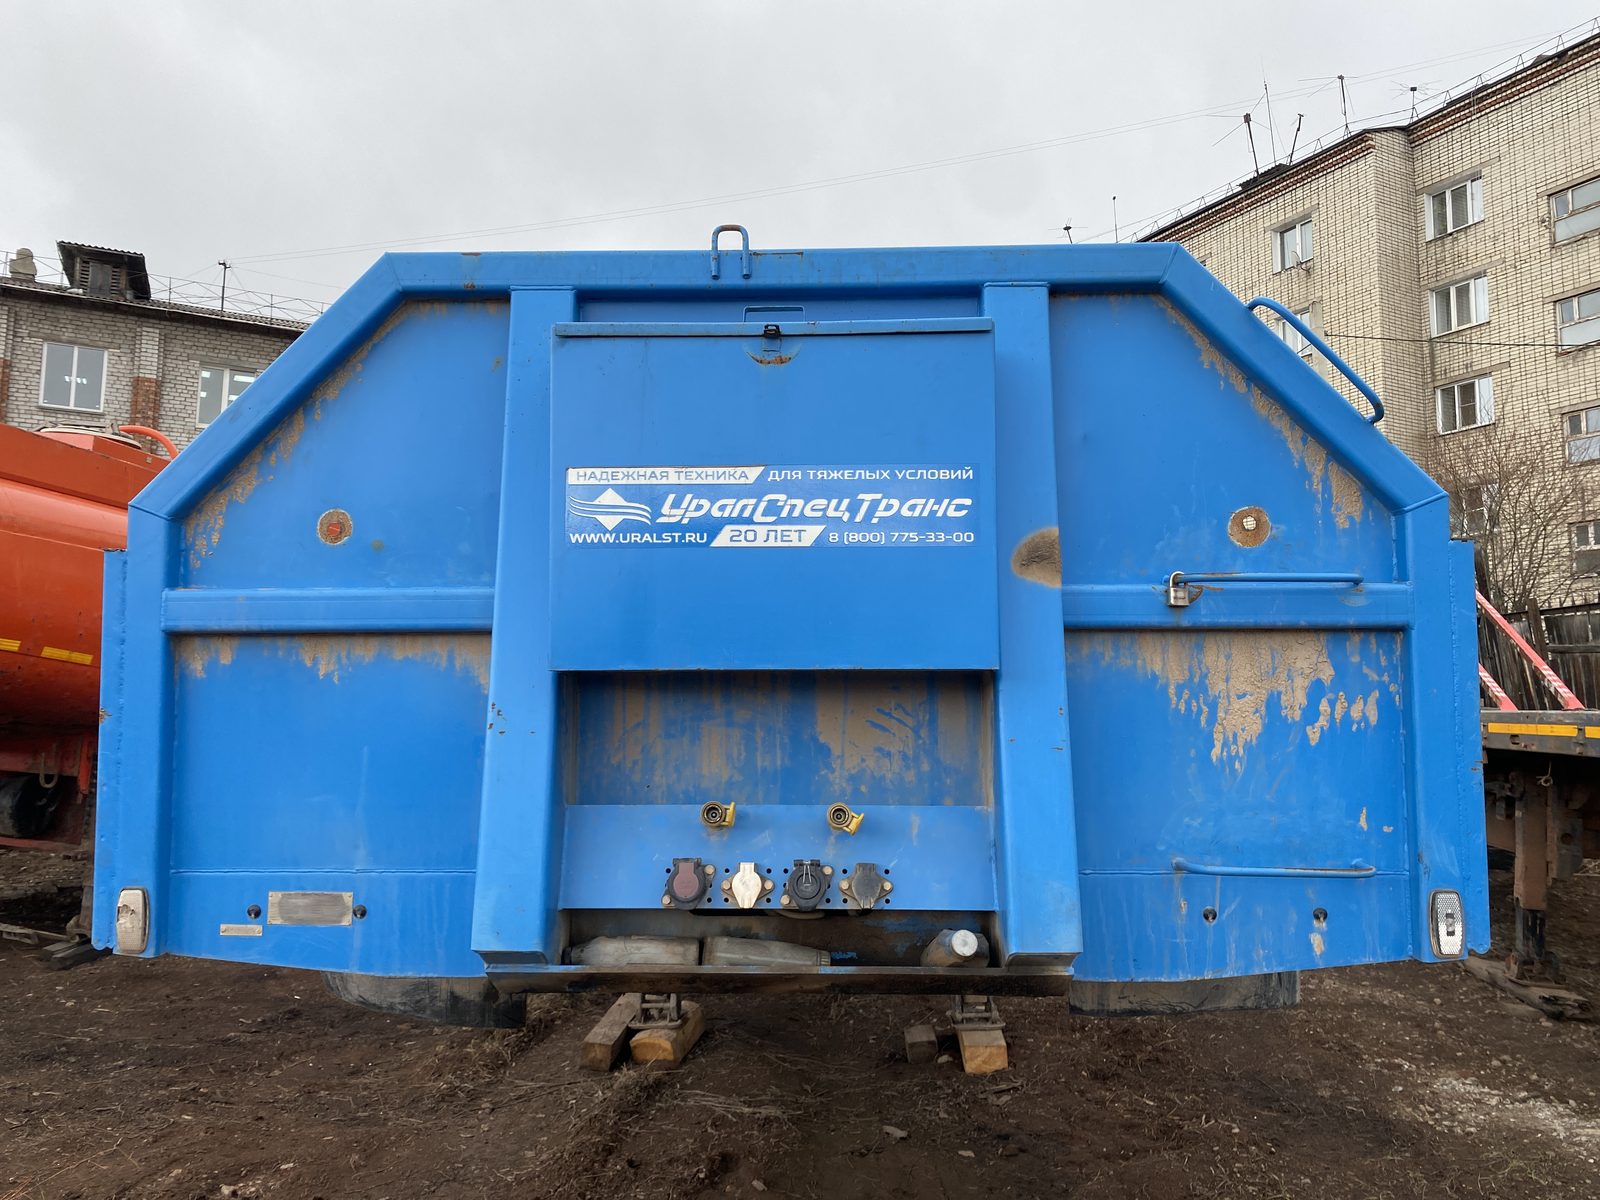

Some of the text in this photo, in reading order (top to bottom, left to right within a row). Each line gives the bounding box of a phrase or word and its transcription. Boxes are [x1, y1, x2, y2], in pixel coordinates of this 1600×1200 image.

[576, 466, 974, 483] НАДЕЖНАЯ ТЕХНИКА ДЛЯ ТЯЖЕЛЫХ УСЛОВИЙ
[569, 532, 708, 544] WWW.URALST.RU
[729, 529, 807, 543] 20 ЛЕТ
[828, 531, 975, 545] 8 (800) 775-33-00
